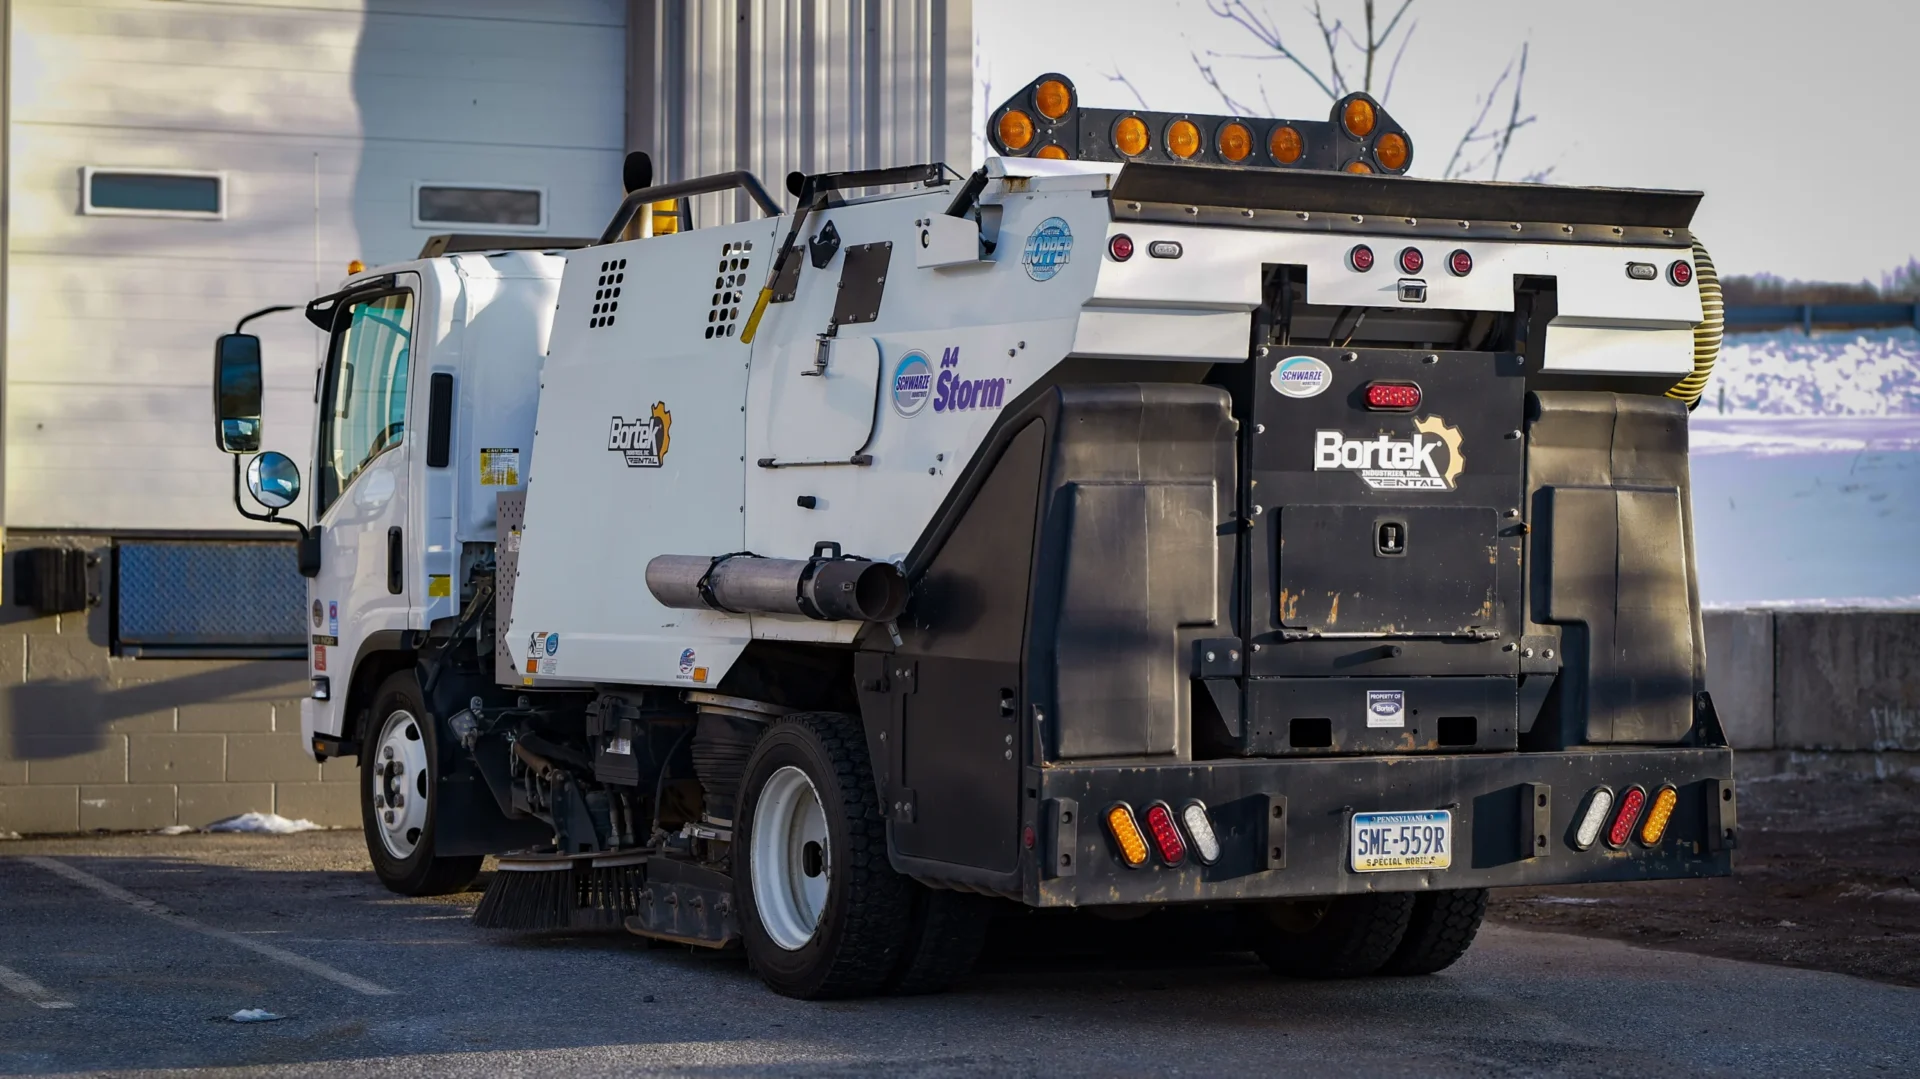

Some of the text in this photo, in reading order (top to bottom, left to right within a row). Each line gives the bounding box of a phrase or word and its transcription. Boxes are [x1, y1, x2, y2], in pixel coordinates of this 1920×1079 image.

[1022, 235, 1073, 265] HOPPER
[940, 346, 960, 369] A4
[895, 374, 931, 391] SCHWARZE
[1281, 370, 1323, 381] SCHWARZE
[933, 369, 1005, 412] Storm
[608, 417, 659, 456] Bortek
[1316, 431, 1441, 478] Bortek
[1368, 478, 1443, 487] RENTAL
[1376, 704, 1397, 713] Bortek
[1376, 814, 1428, 824] PENNSYLVANIA
[1357, 825, 1446, 856] SME-559R
[1366, 857, 1403, 867] SPECIAL
